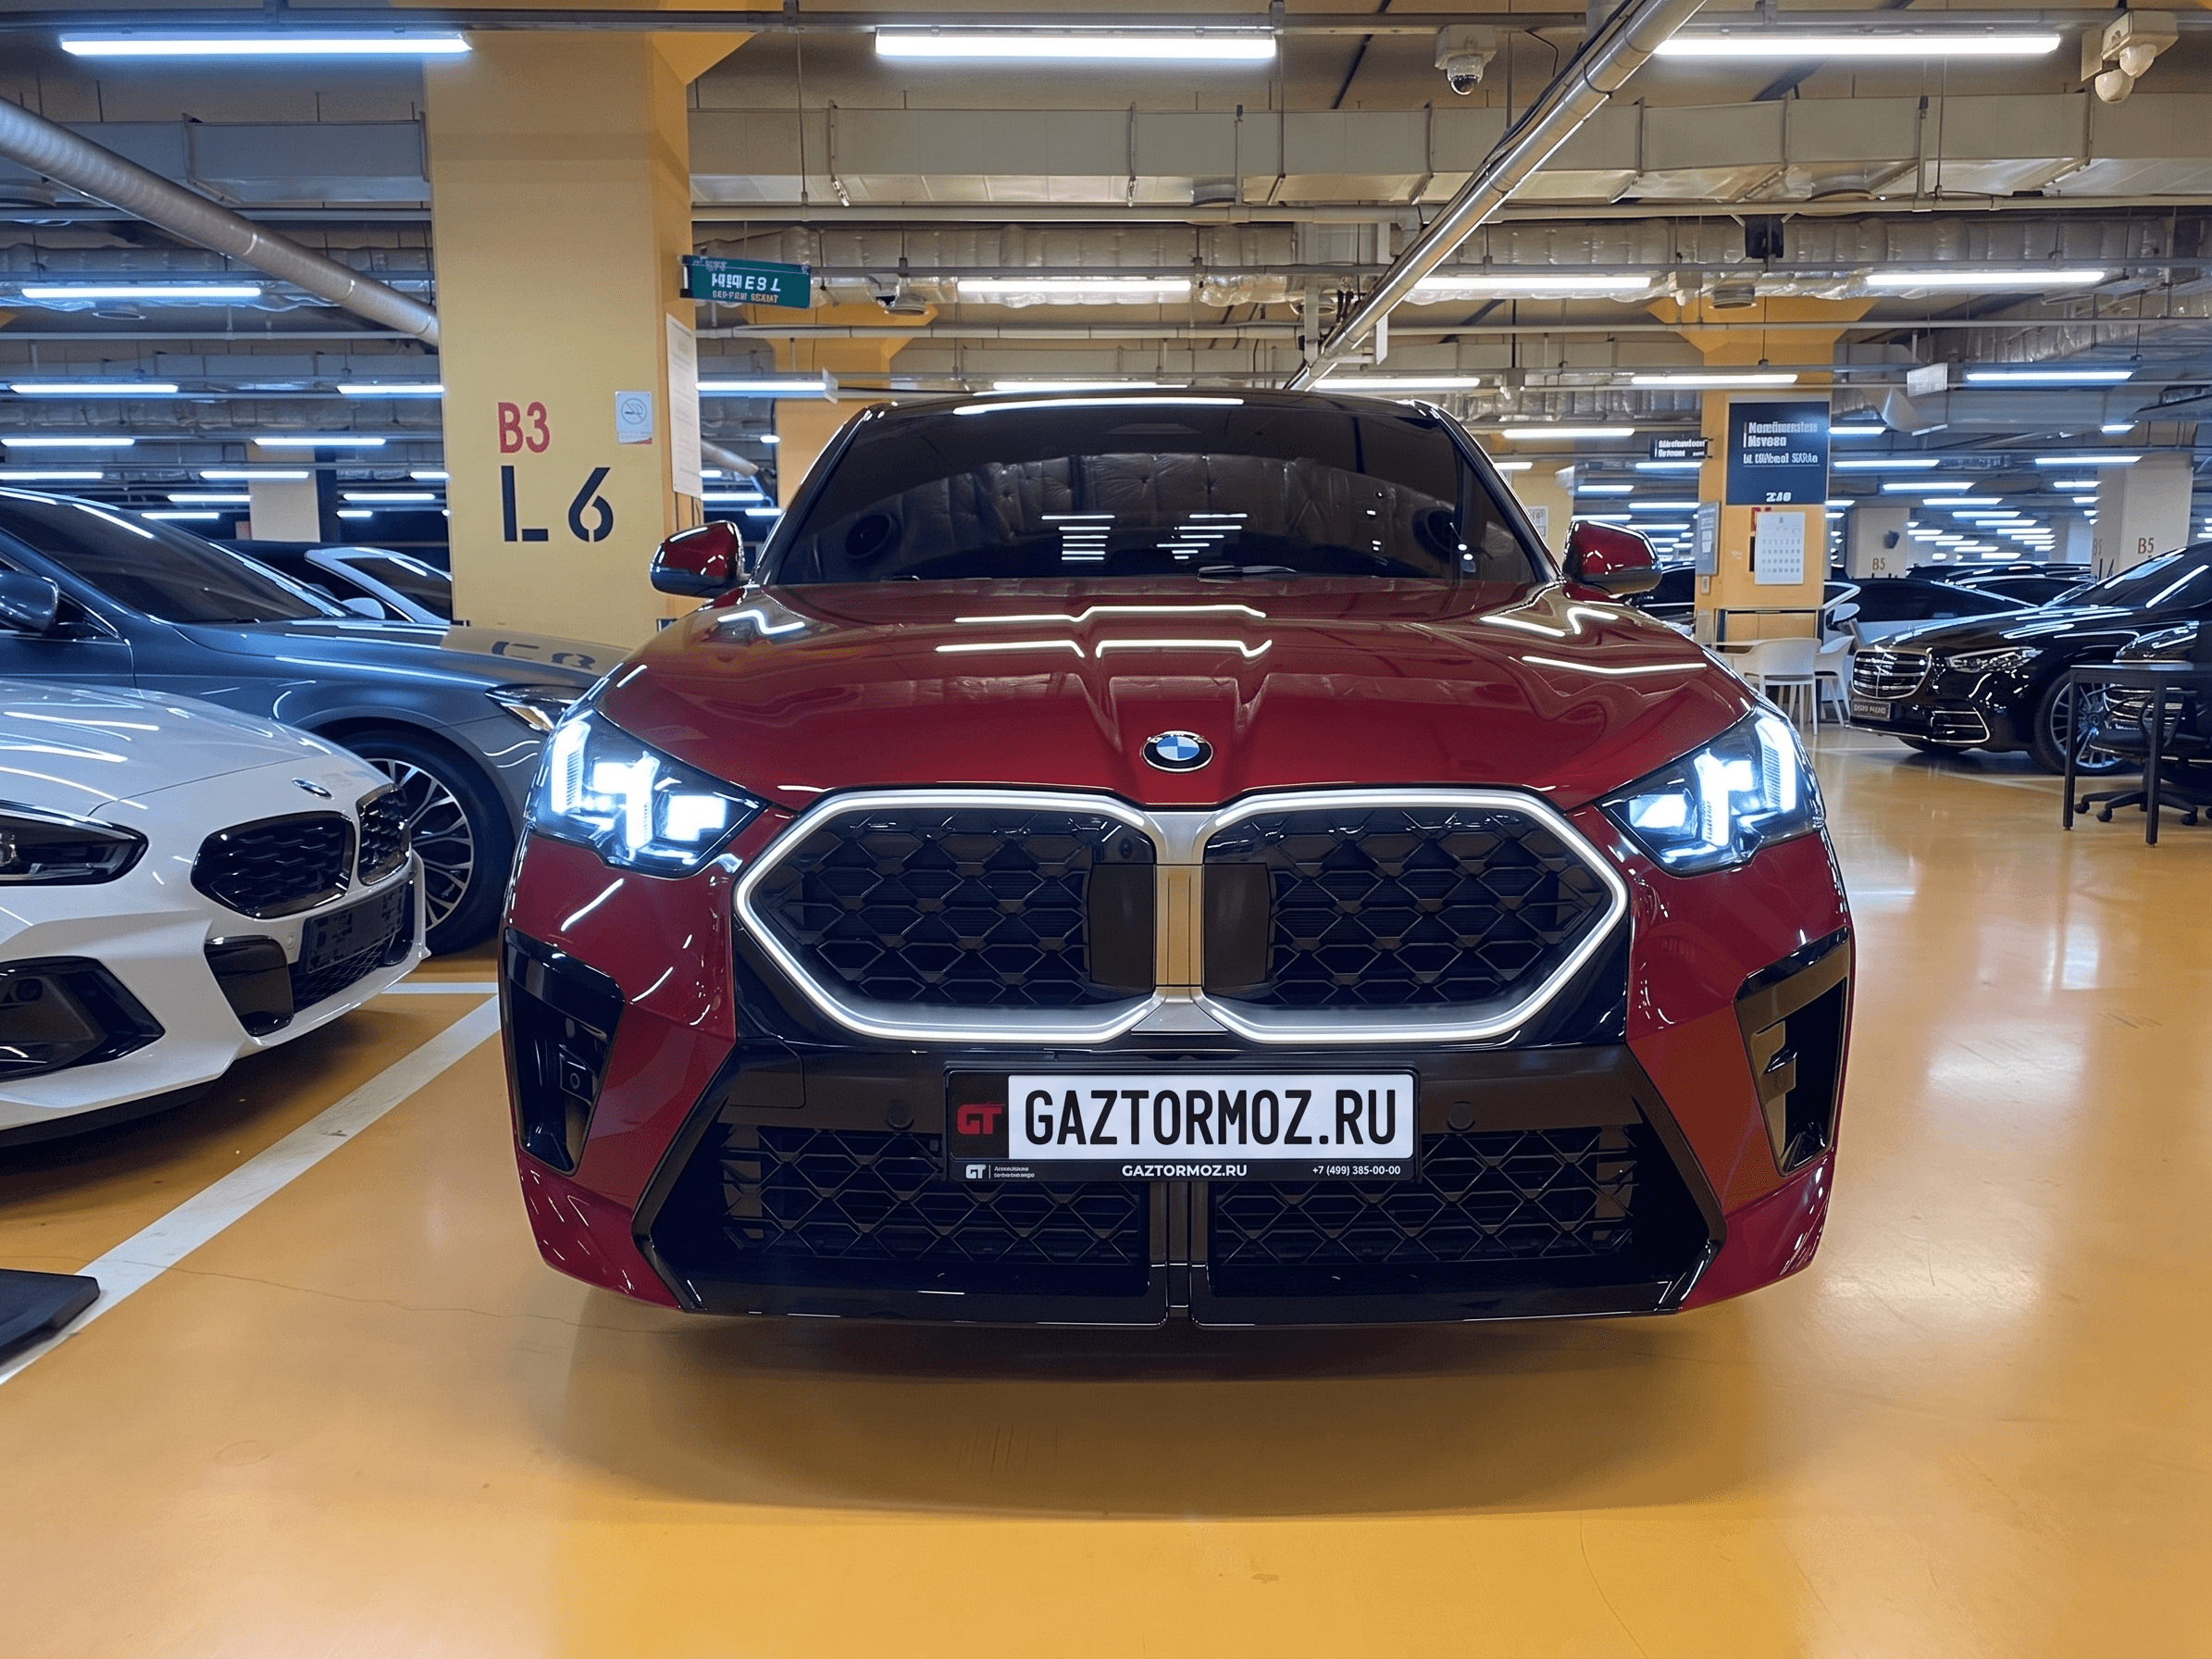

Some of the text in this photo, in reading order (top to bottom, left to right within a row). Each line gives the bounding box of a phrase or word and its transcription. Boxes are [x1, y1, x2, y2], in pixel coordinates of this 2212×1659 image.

[498, 402, 550, 454] B3
[501, 465, 615, 543] L 6
[2137, 537, 2155, 555] B5
[956, 1104, 1003, 1135] GT
[1025, 1089, 1396, 1146] GAZTORMOZ.RU
[965, 1164, 987, 1179] GT
[1121, 1164, 1248, 1177] GAZTORMOZ.RU
[1311, 1165, 1401, 1177] +7 (499) 385-00-00
